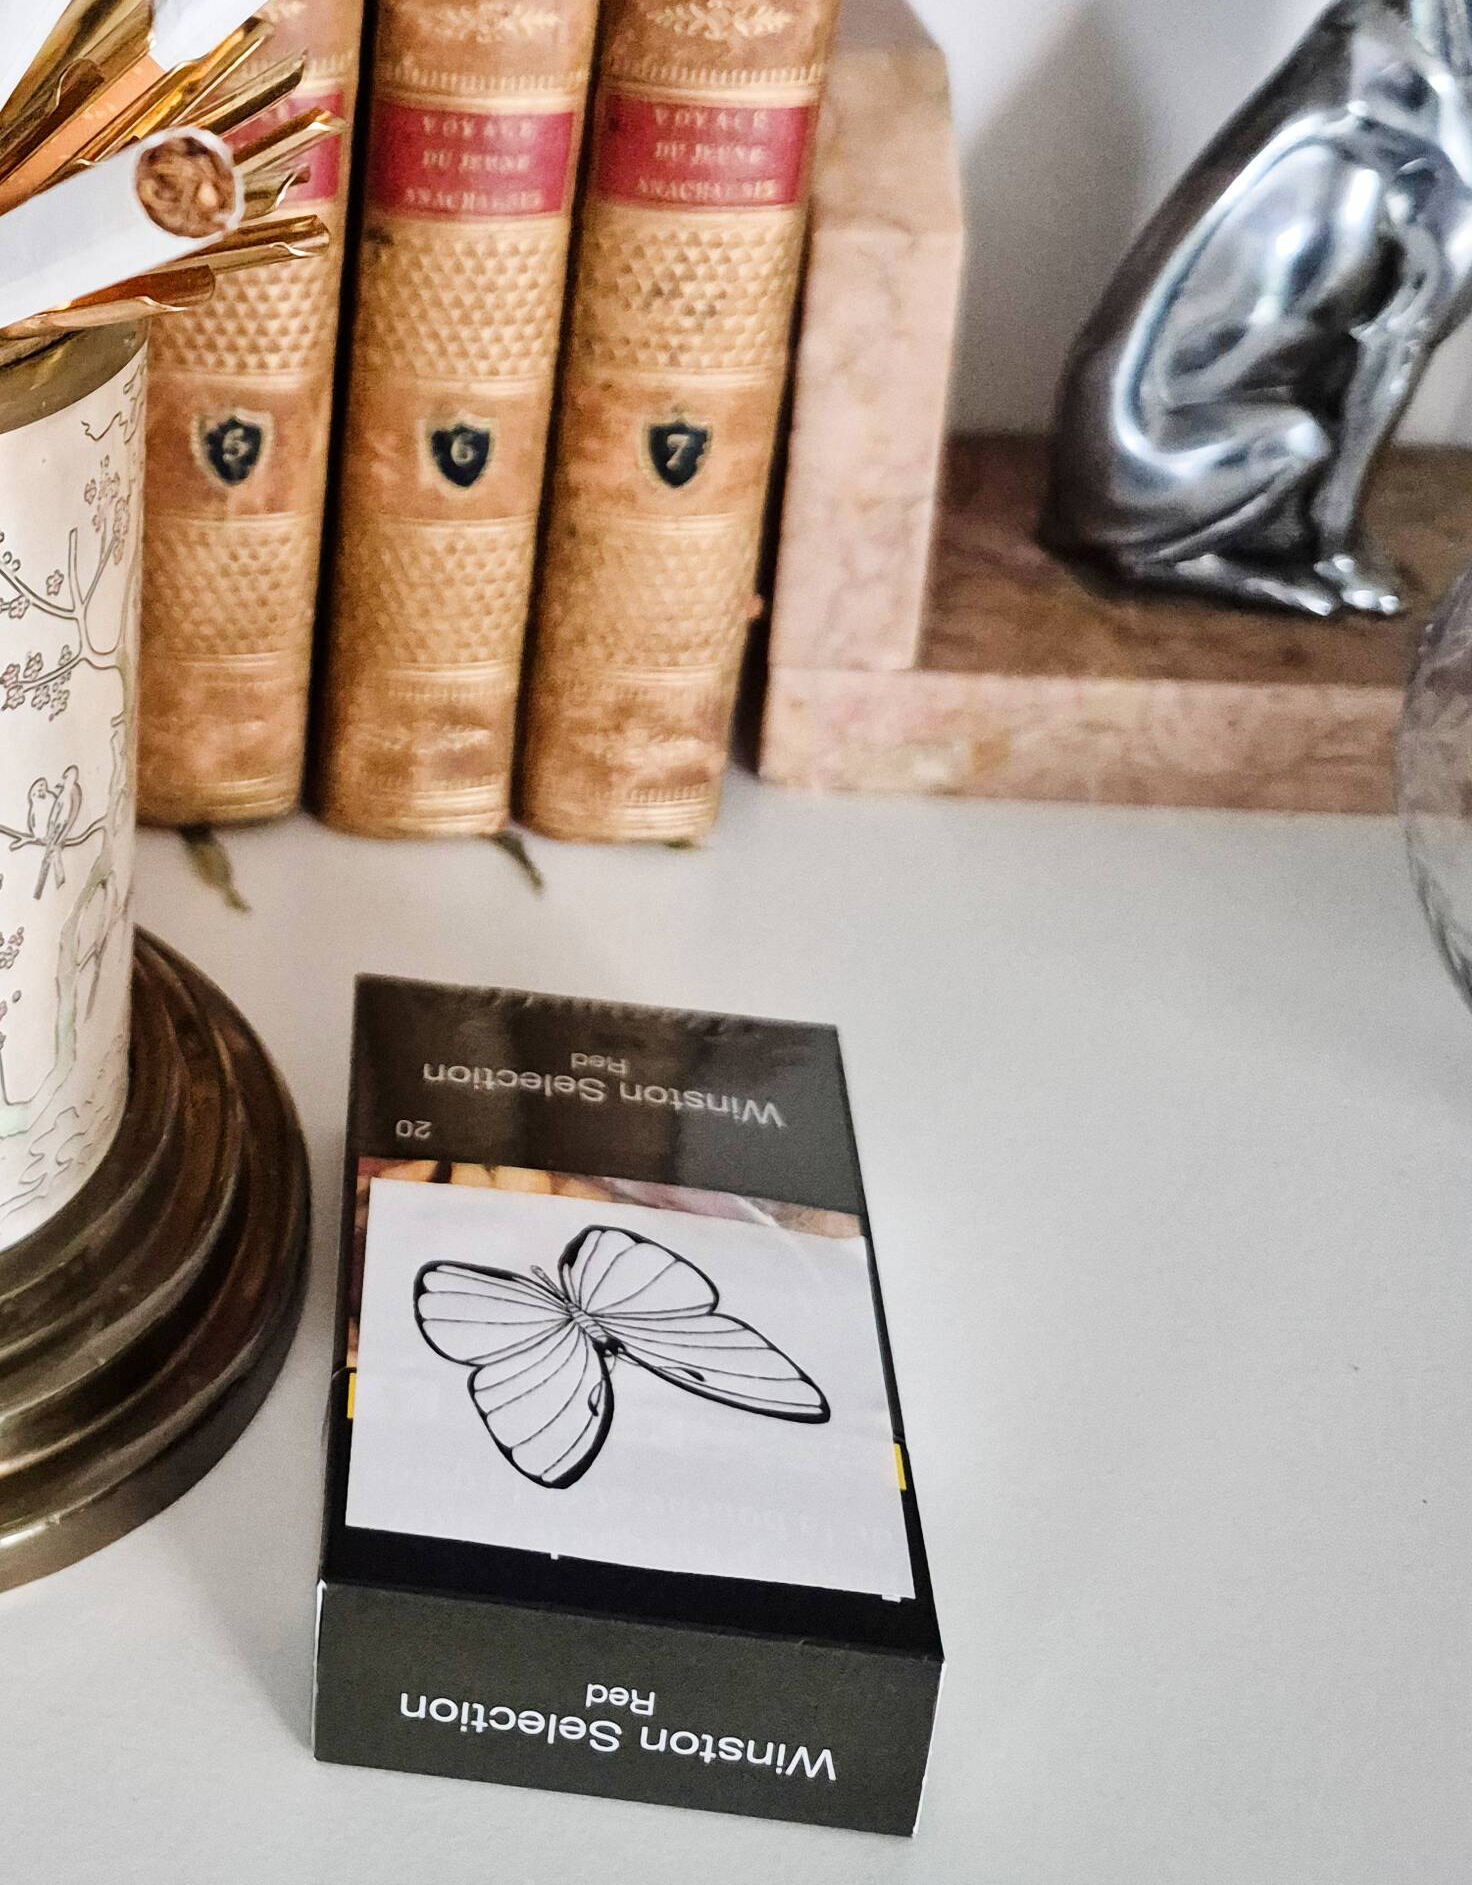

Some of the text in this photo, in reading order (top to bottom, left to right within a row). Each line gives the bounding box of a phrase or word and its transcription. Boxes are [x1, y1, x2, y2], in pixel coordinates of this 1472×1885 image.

[222, 428, 251, 463] 5
[450, 433, 475, 466] 6
[666, 433, 691, 469] 7
[570, 1052, 628, 1075] Red
[422, 1062, 787, 1129] Winston Selection
[394, 1118, 433, 1139] 20
[584, 1683, 656, 1716] Red
[399, 1691, 837, 1782] Winston Selection
